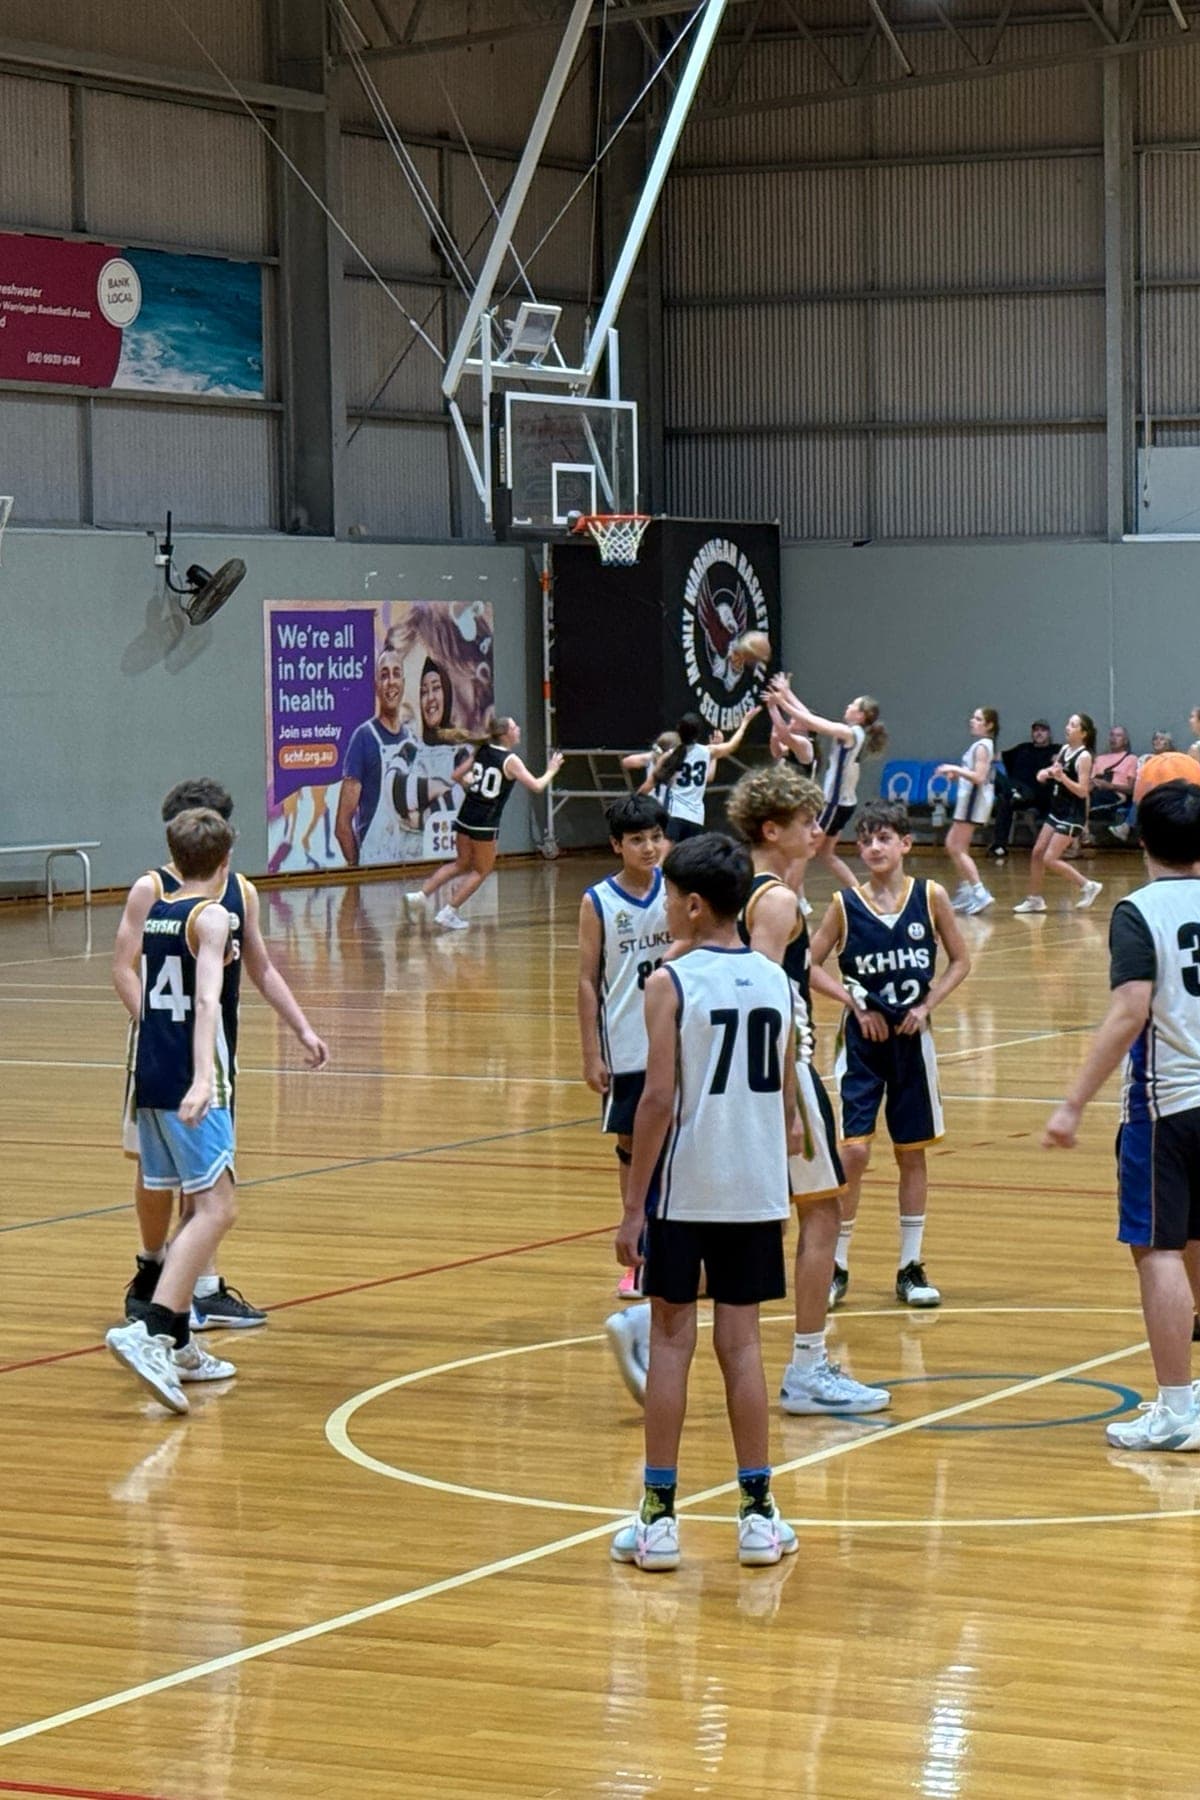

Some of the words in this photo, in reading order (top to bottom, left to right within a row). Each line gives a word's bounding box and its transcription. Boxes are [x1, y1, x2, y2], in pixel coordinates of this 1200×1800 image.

[108, 277, 130, 289] BANK
[107, 292, 133, 304] LOCAL
[683, 537, 738, 607] WARRINGAH
[334, 624, 354, 649] all
[681, 607, 702, 688] MANLY
[278, 656, 295, 681] in
[299, 655, 326, 681] for
[278, 688, 335, 713] health
[700, 691, 720, 729] SEA
[278, 727, 301, 740] Join
[301, 728, 313, 739] us
[314, 725, 342, 741] today
[283, 751, 334, 766] schf.org.au
[676, 760, 707, 788] 33
[619, 938, 637, 954] ST
[855, 948, 930, 975] KHHS
[879, 978, 921, 1005] 12
[708, 1007, 783, 1096] 70
